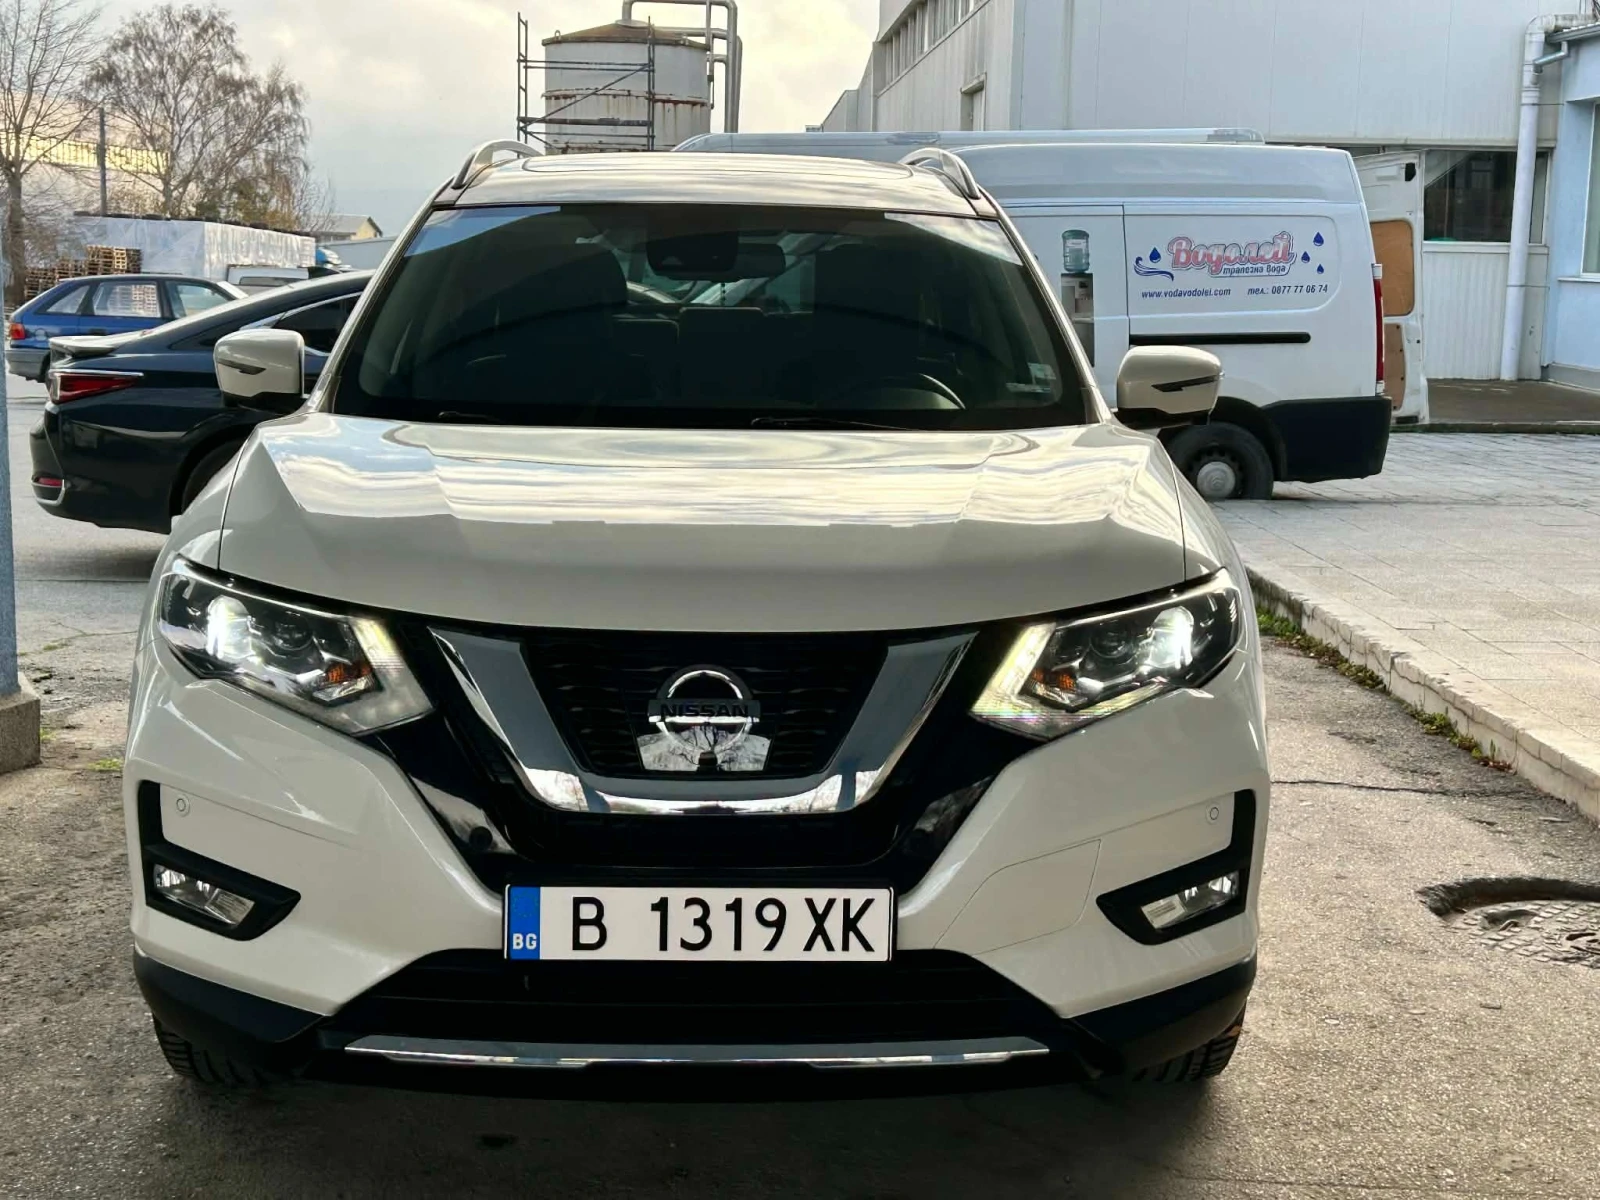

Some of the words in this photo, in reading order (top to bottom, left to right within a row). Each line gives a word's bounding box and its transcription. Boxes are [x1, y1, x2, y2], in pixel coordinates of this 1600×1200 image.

[1168, 232, 1296, 274] Водолей
[1223, 266, 1264, 276] трапезна
[1142, 287, 1231, 298] www.vodavodolei.com
[1271, 285, 1292, 294] 0877
[1294, 285, 1304, 293] 77
[1318, 283, 1328, 293] 74
[660, 704, 748, 717] NISSAN
[572, 896, 607, 951] B
[650, 896, 787, 952] 1319
[511, 932, 537, 950] BG
